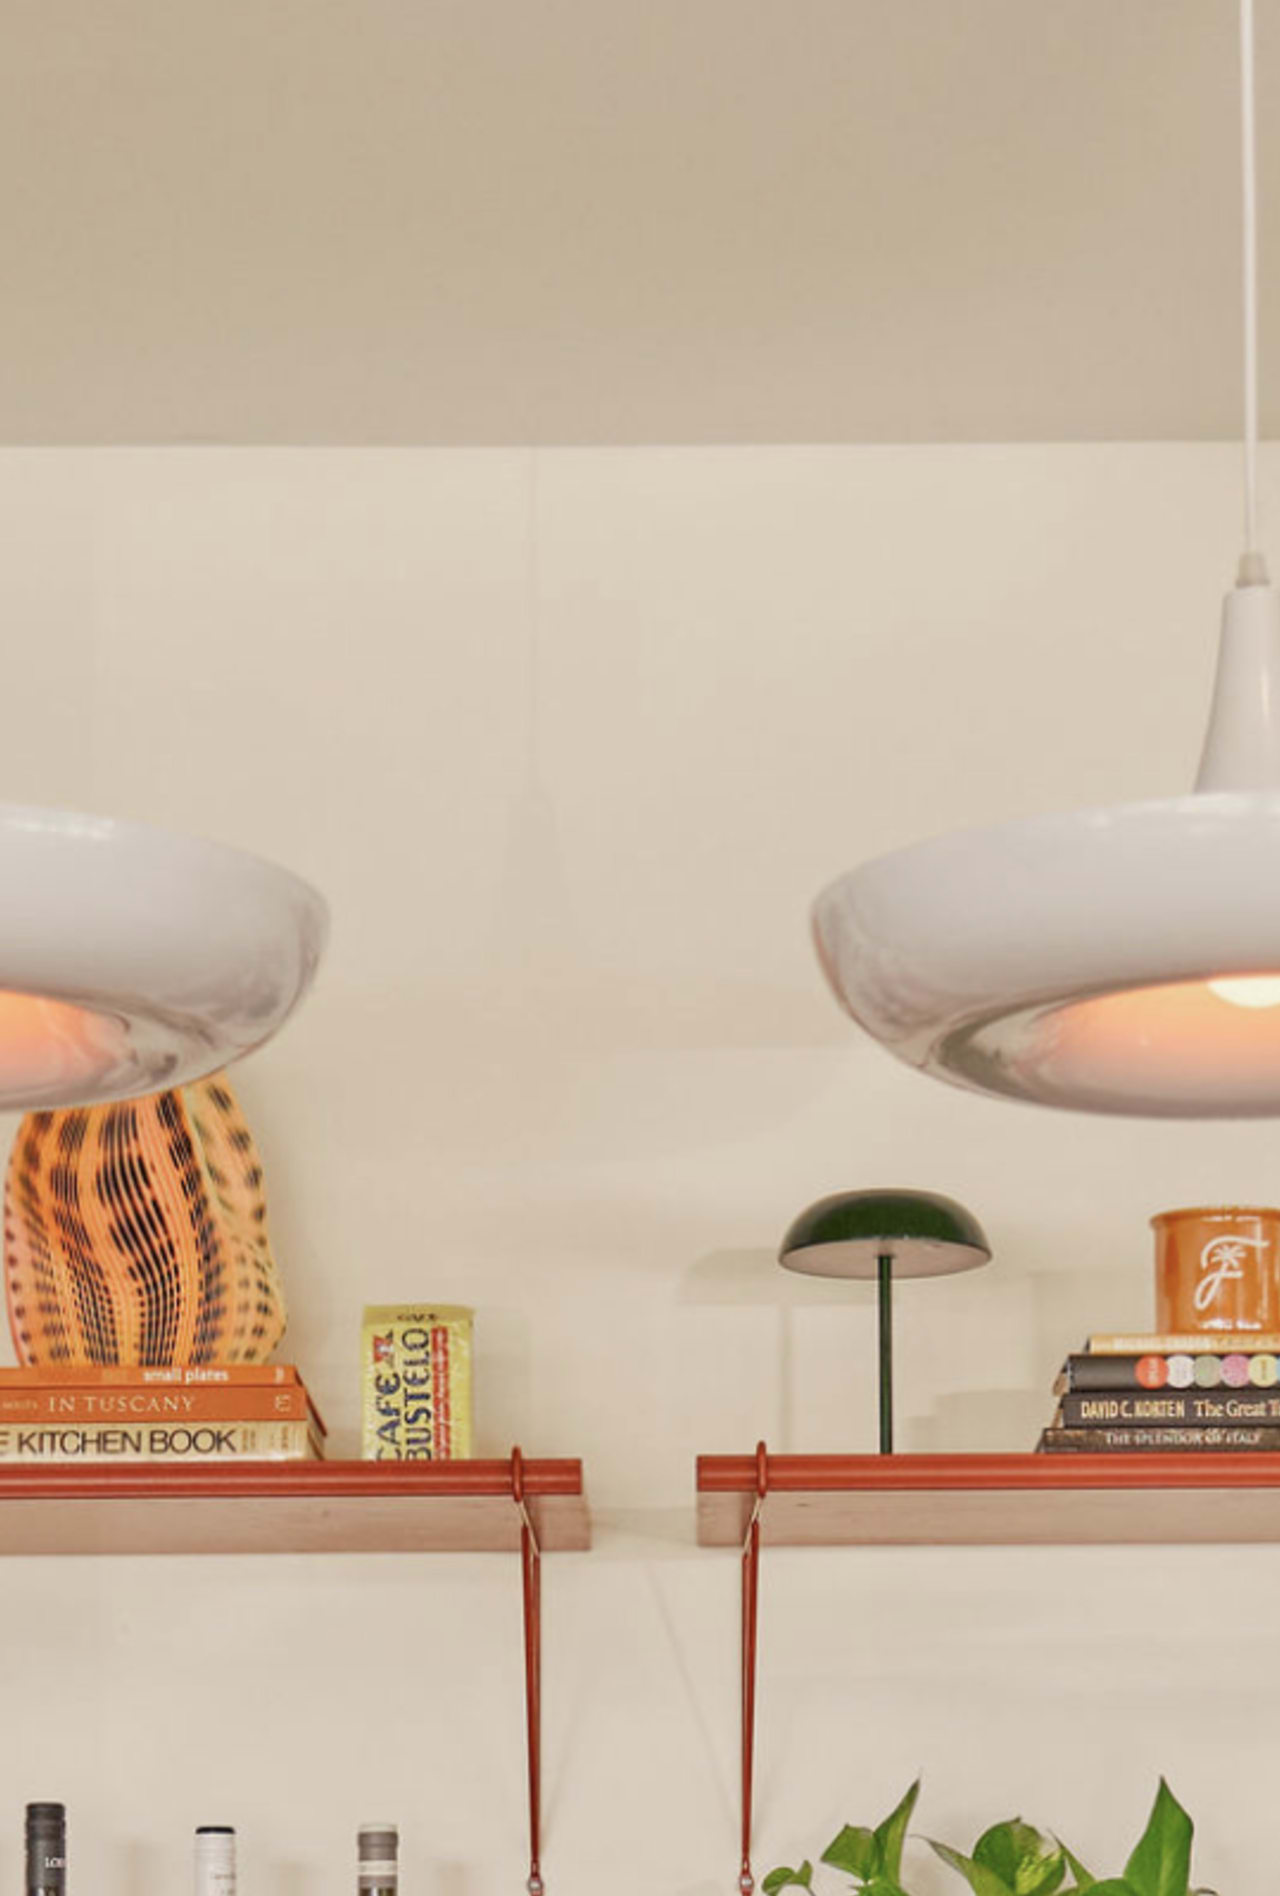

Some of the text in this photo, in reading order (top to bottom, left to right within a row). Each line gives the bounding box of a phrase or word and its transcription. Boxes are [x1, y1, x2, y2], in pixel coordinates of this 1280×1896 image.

[185, 1366, 230, 1384] plates
[48, 1396, 196, 1413] IN TUSCANY
[1080, 1400, 1119, 1419] DAVID
[1194, 1399, 1222, 1417] The
[1225, 1399, 1267, 1418] Great
[19, 1430, 143, 1455] KITCHEN
[149, 1429, 238, 1453] BOOK
